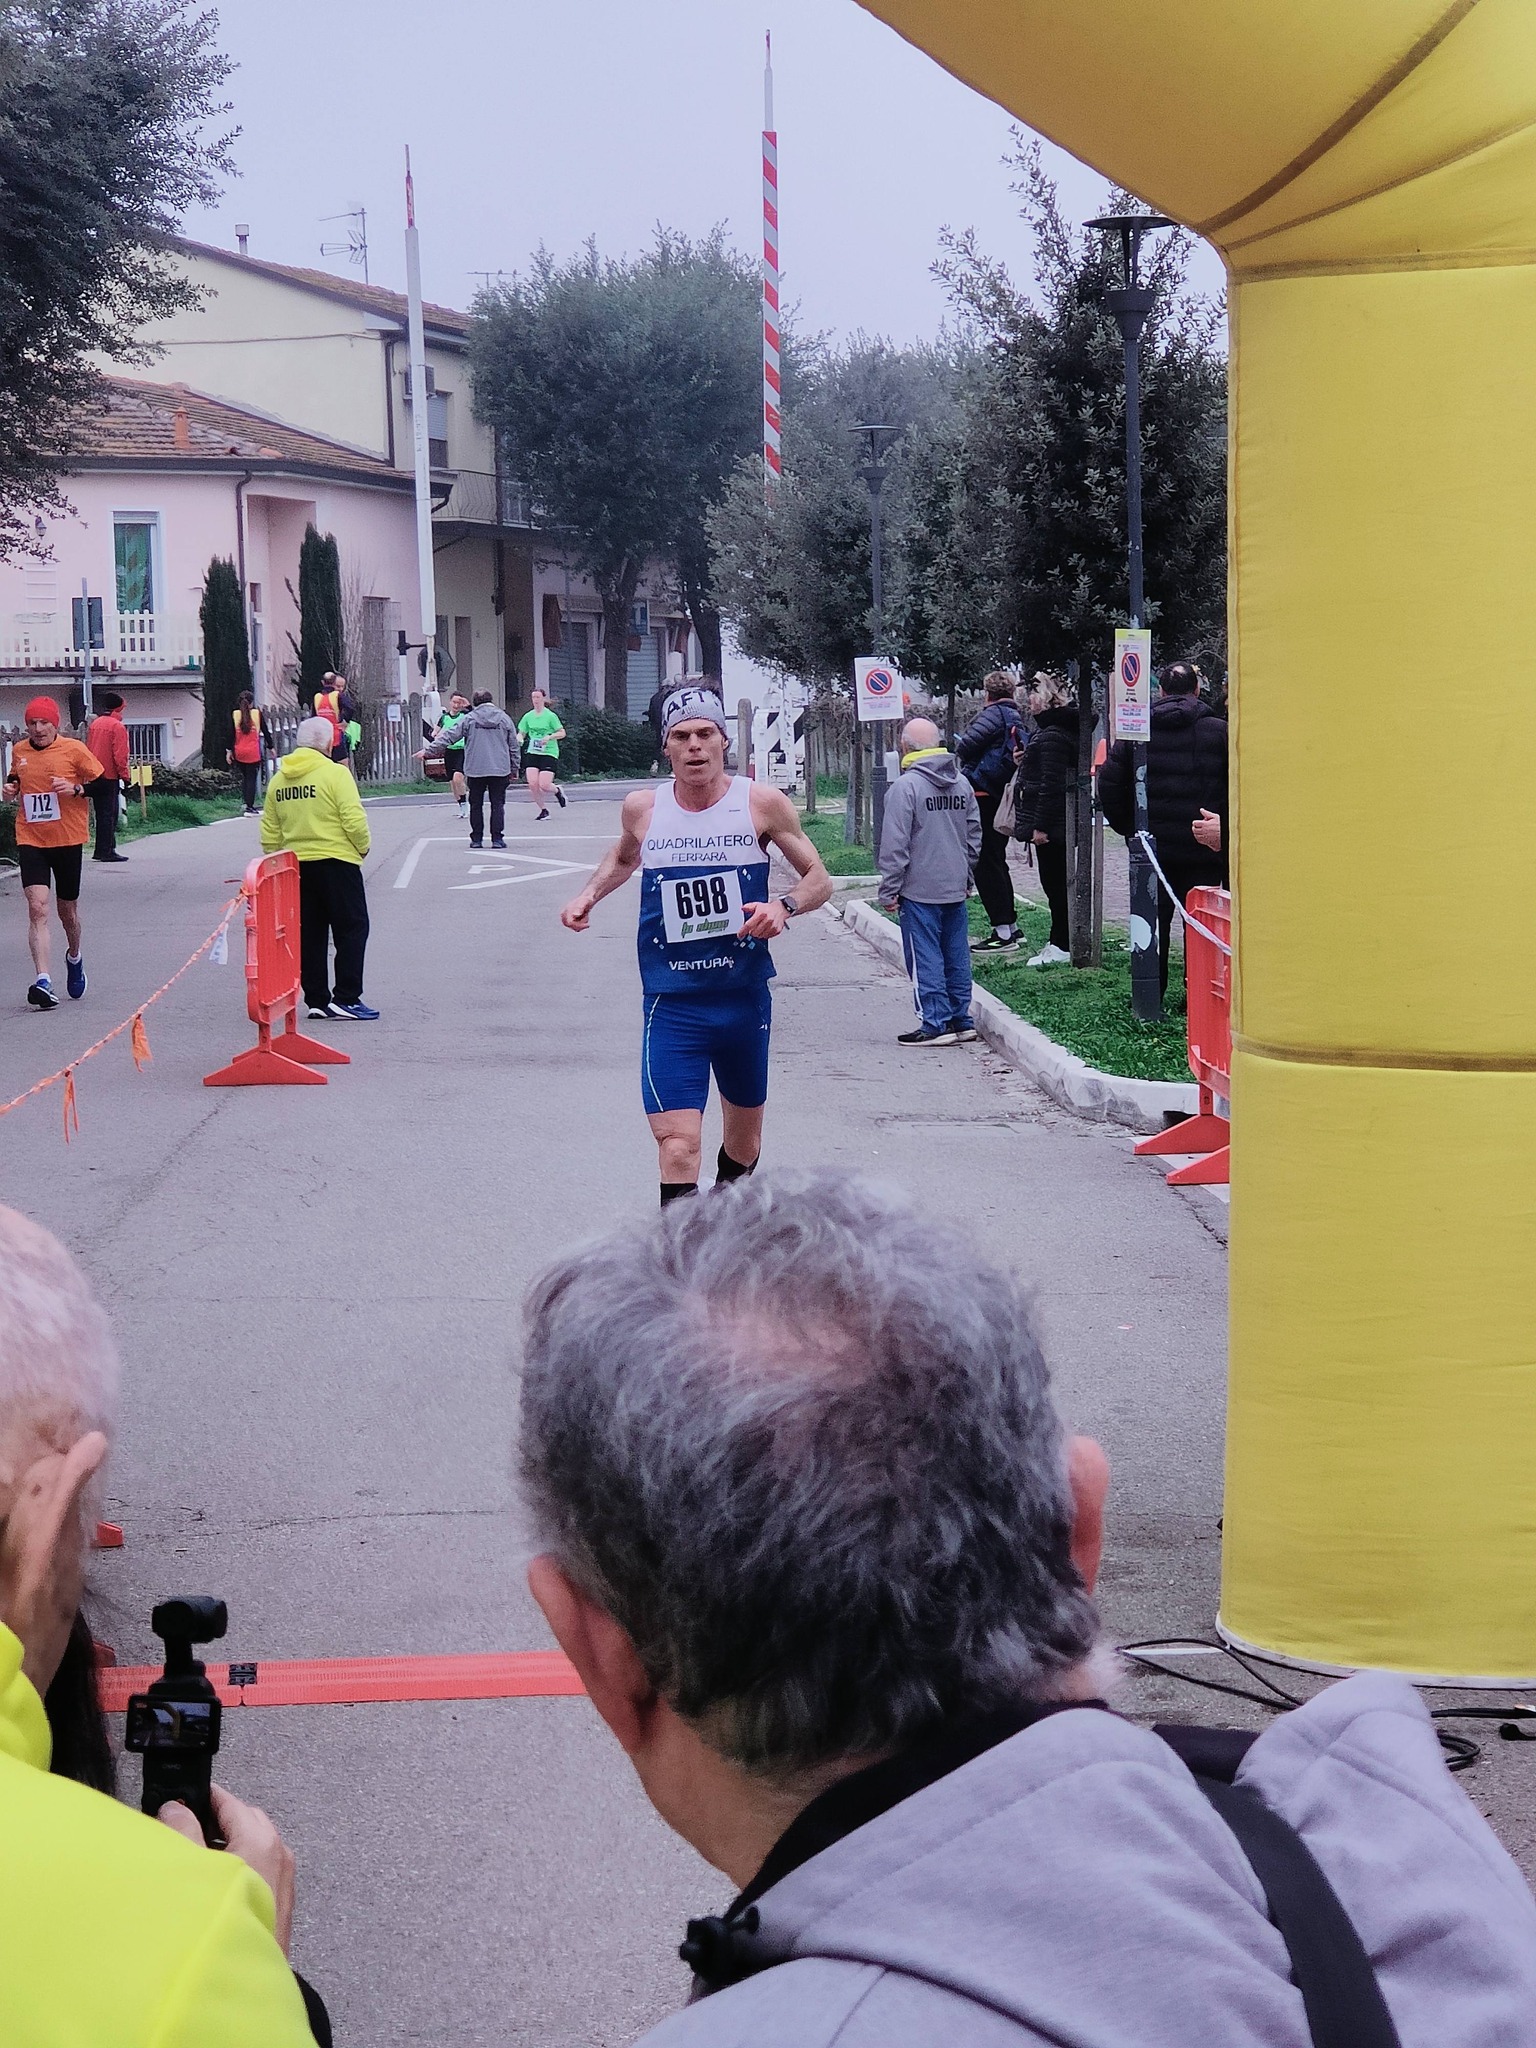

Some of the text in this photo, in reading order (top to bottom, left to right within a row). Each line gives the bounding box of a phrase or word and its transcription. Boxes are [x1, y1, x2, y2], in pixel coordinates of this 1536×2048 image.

[664, 690, 706, 722] AFT
[276, 785, 316, 802] GIUDICE
[31, 794, 53, 812] 712
[926, 795, 966, 811] GIUDICE
[647, 834, 754, 850] QUADRILATERO
[672, 852, 727, 863] FERRARA
[675, 876, 729, 919] 698
[668, 956, 729, 971] VENTURA
